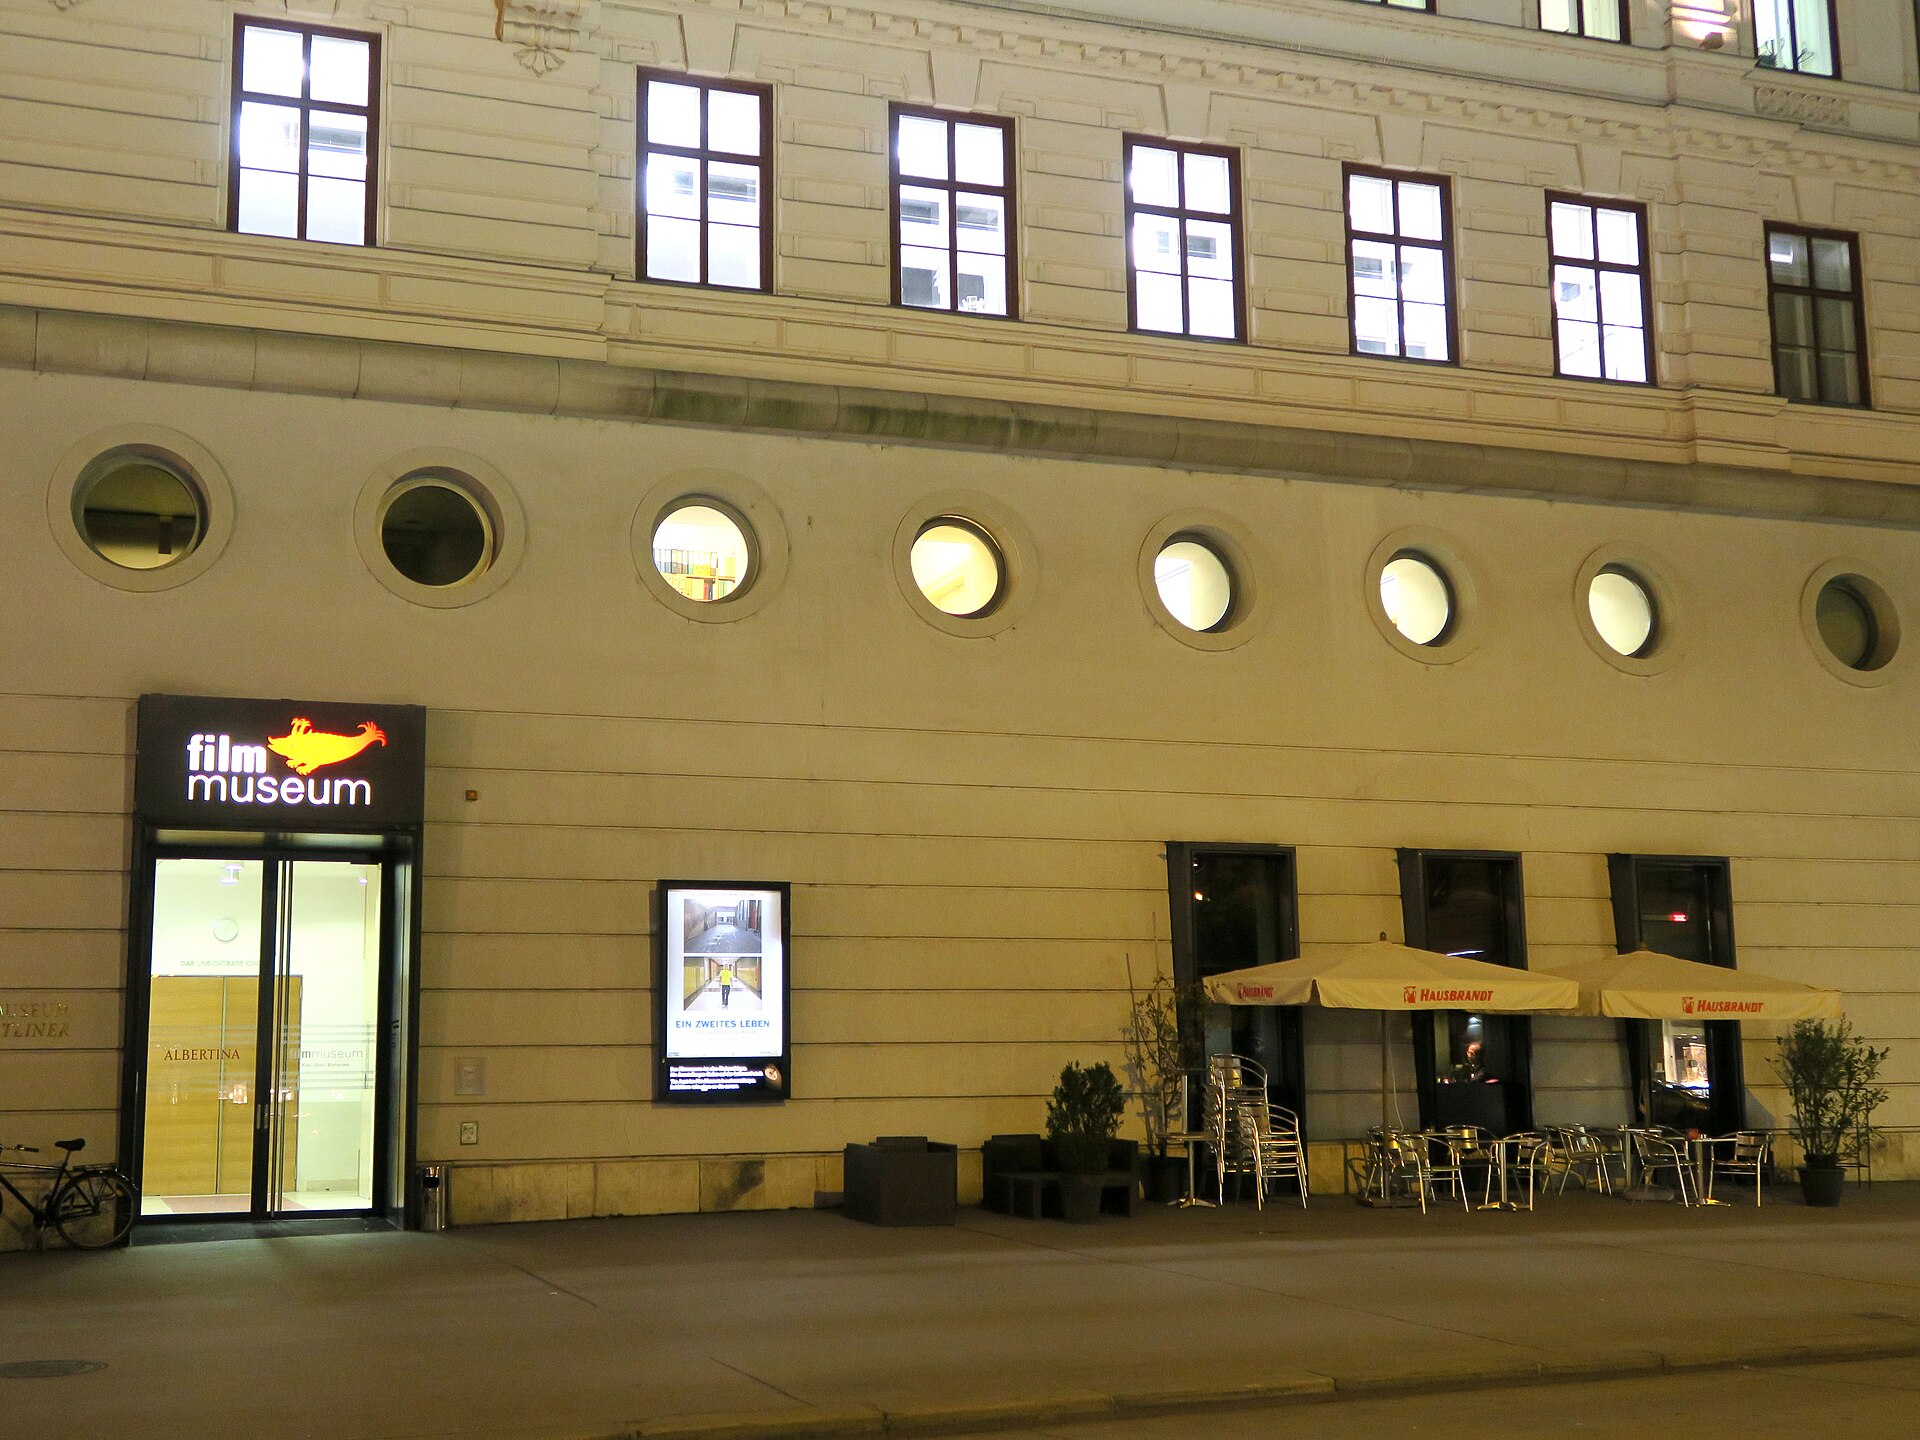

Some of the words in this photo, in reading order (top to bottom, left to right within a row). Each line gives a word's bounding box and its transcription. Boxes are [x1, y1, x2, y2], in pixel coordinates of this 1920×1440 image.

[187, 734, 267, 774] film
[187, 774, 371, 806] museum
[1420, 988, 1494, 1002] HAUSBRANDT
[1696, 1000, 1764, 1013] HAUSBRANDT
[675, 1020, 692, 1029] EIN
[695, 1020, 737, 1029] ZWEITES
[739, 1020, 770, 1028] LEBEN
[164, 1048, 240, 1061] ALBERTINA
